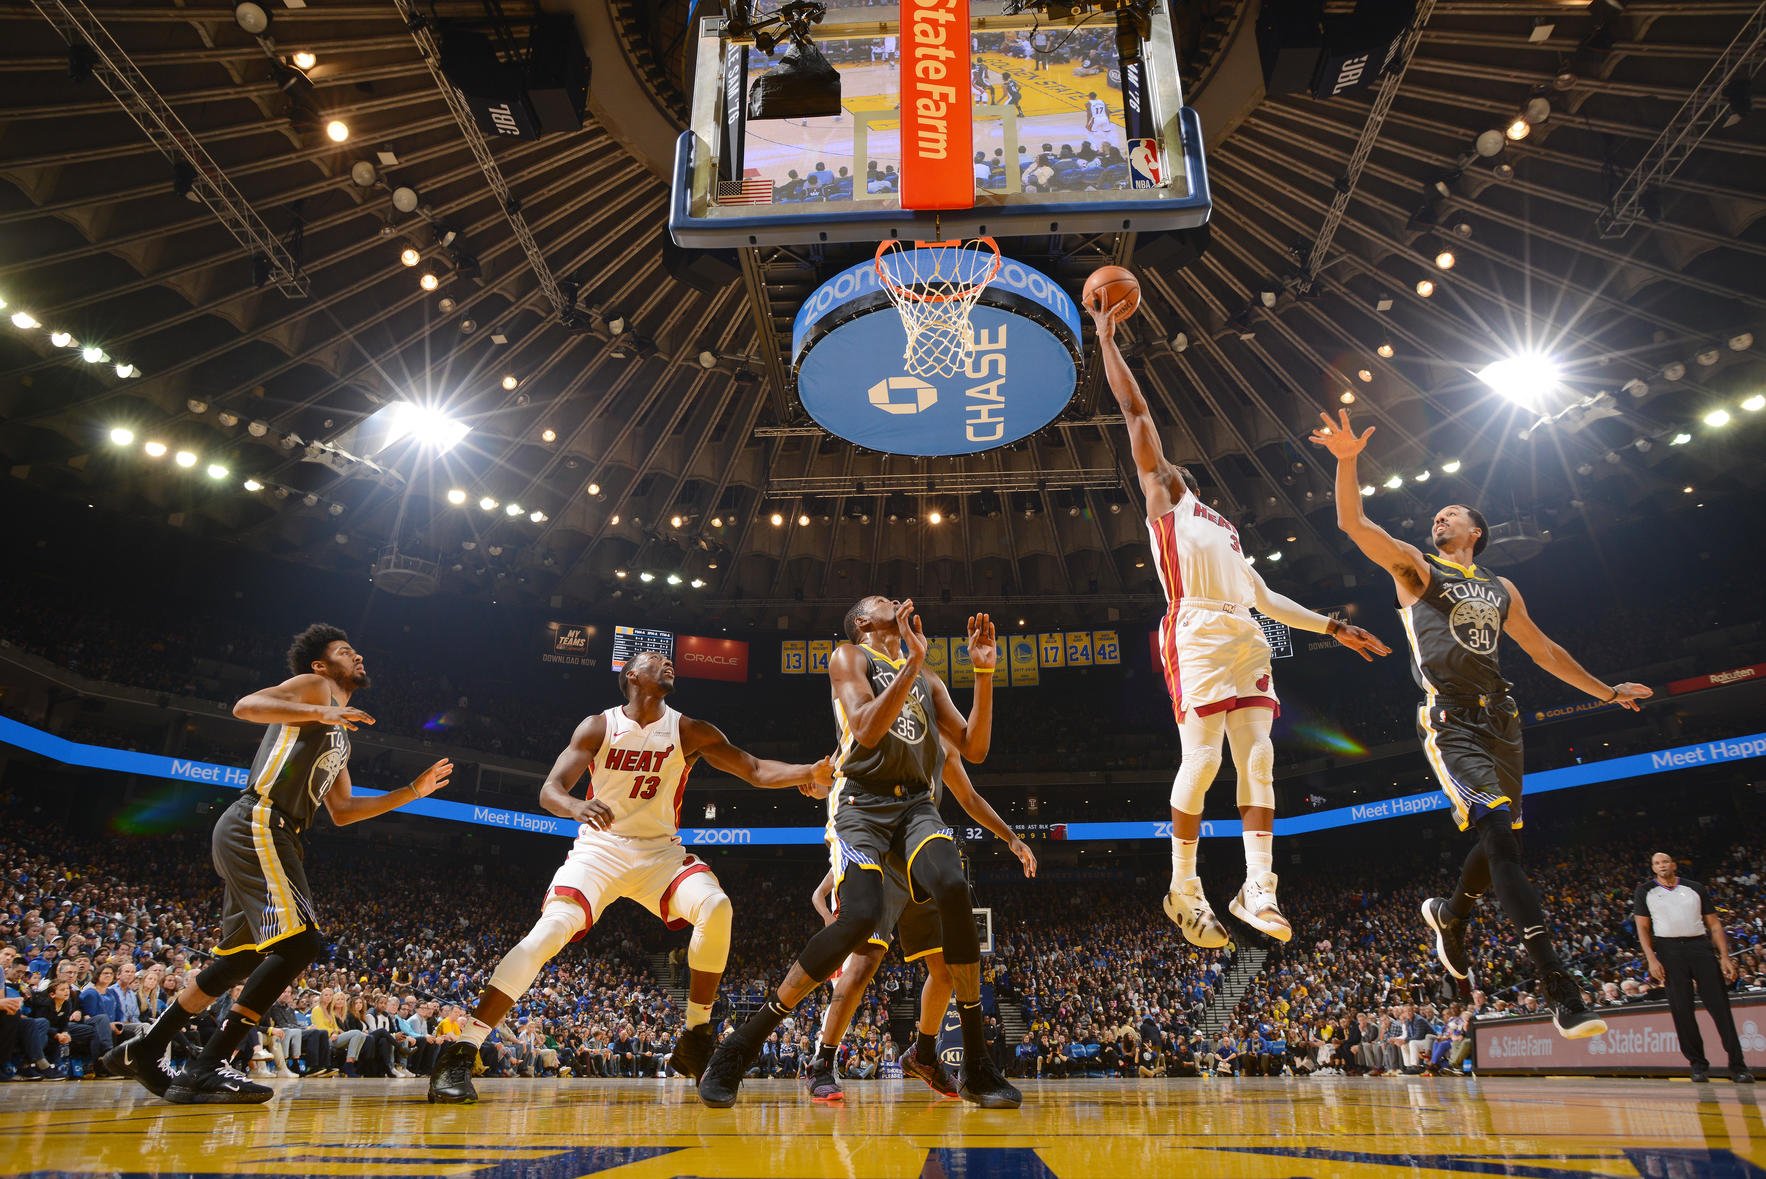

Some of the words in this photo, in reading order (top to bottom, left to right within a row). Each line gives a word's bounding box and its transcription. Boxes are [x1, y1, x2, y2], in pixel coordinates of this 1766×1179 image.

[728, 65, 739, 100] SAM
[1135, 180, 1151, 189] NBA
[804, 263, 885, 326] zoom
[980, 256, 1070, 318] zoom
[964, 324, 1007, 442] CHASE
[1439, 582, 1501, 608] TOWN
[559, 636, 586, 647] TEAMS
[567, 629, 581, 638] MY
[1468, 628, 1490, 649] 34
[683, 652, 739, 666] ORACLE
[1043, 646, 1060, 663] 17
[1069, 645, 1090, 662] 24
[1097, 643, 1118, 660] 42
[542, 653, 580, 665] DOWNLOAD
[580, 657, 597, 668] NOW
[786, 653, 802, 669] 13
[813, 652, 829, 669] 14
[1709, 668, 1755, 684] Rakuten
[1546, 706, 1574, 718] GOLD
[897, 716, 916, 740] 35
[604, 743, 675, 773] HEAT
[1651, 747, 1707, 769] Meet
[1709, 737, 1766, 759] Happ
[171, 759, 221, 781] Meet
[628, 775, 661, 800] 13
[1352, 804, 1389, 821] Meet
[1391, 794, 1443, 814] Happy.
[473, 807, 510, 825] Meet
[513, 812, 558, 833] Happy.
[693, 829, 750, 844] zoom
[966, 828, 983, 840] 32
[1153, 821, 1214, 837] zom
[1501, 1034, 1552, 1057] StateFarm
[1608, 1027, 1681, 1055] StateFarm
[946, 1051, 962, 1062] KI
